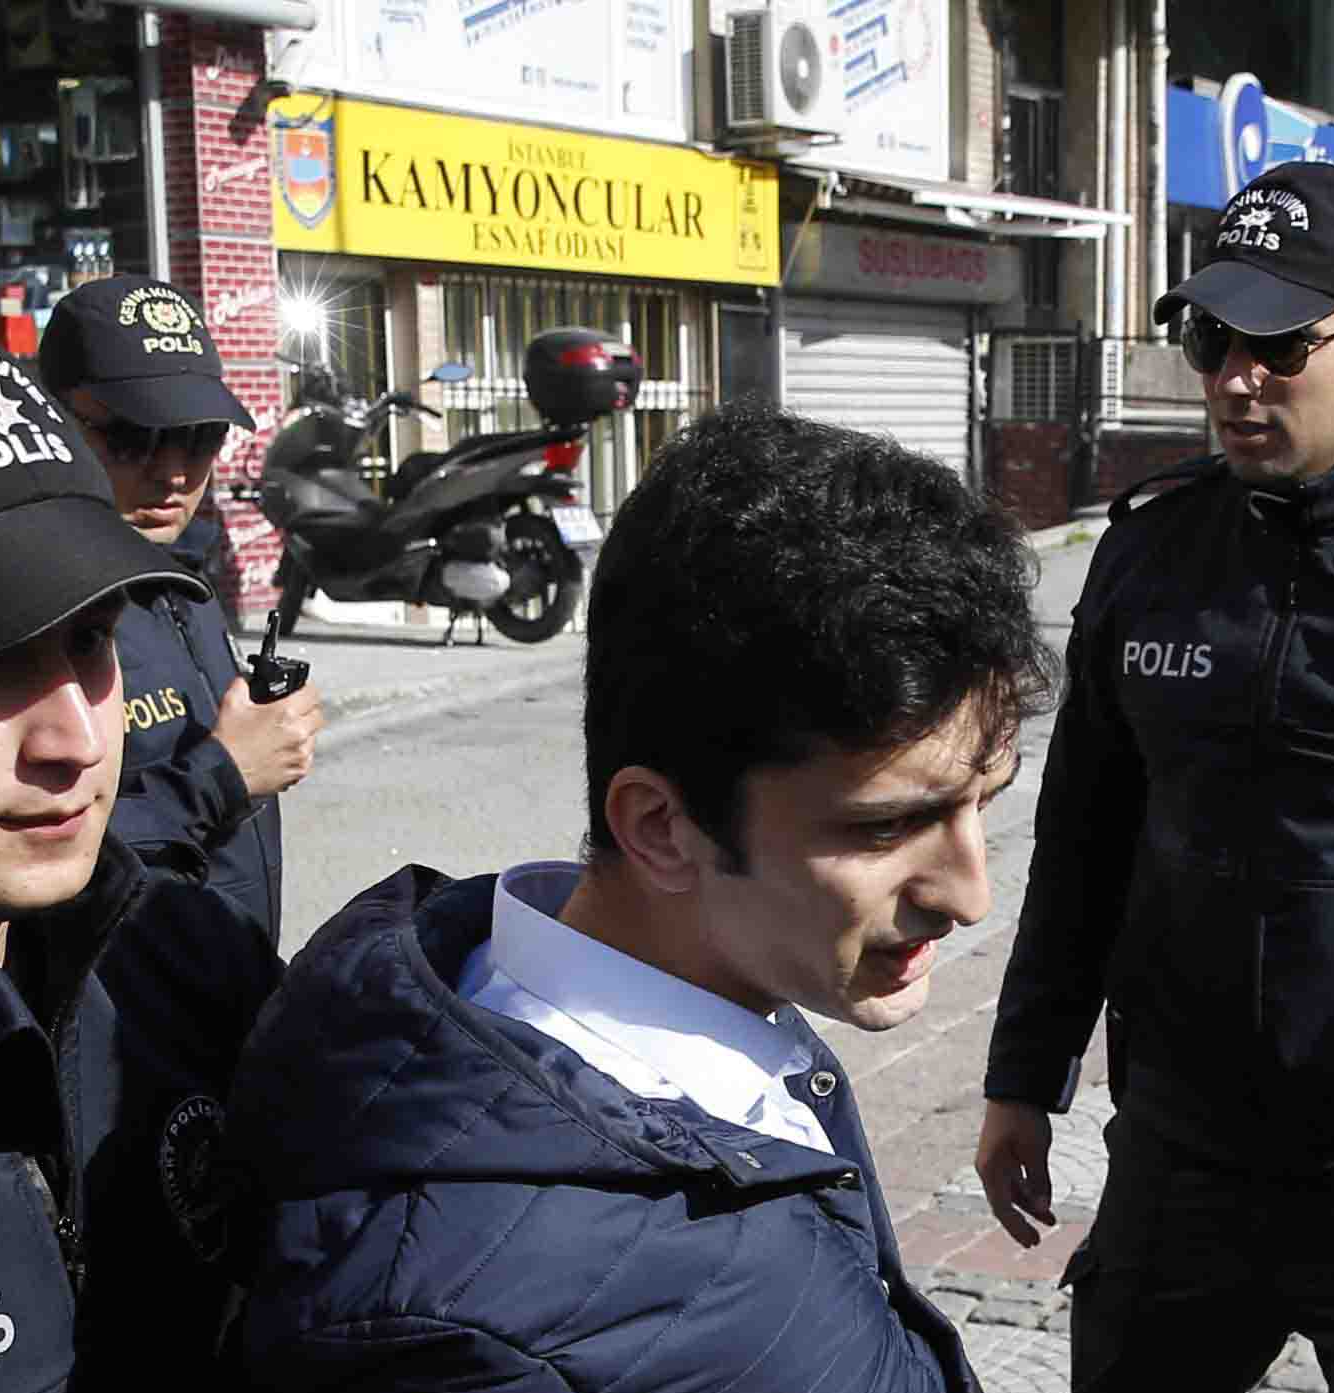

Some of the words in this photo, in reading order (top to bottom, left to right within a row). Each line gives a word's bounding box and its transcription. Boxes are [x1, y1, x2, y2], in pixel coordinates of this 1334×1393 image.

[360, 148, 705, 240] KAMYONCULAR
[473, 222, 549, 257] ESNAF
[556, 230, 626, 264] ODASI
